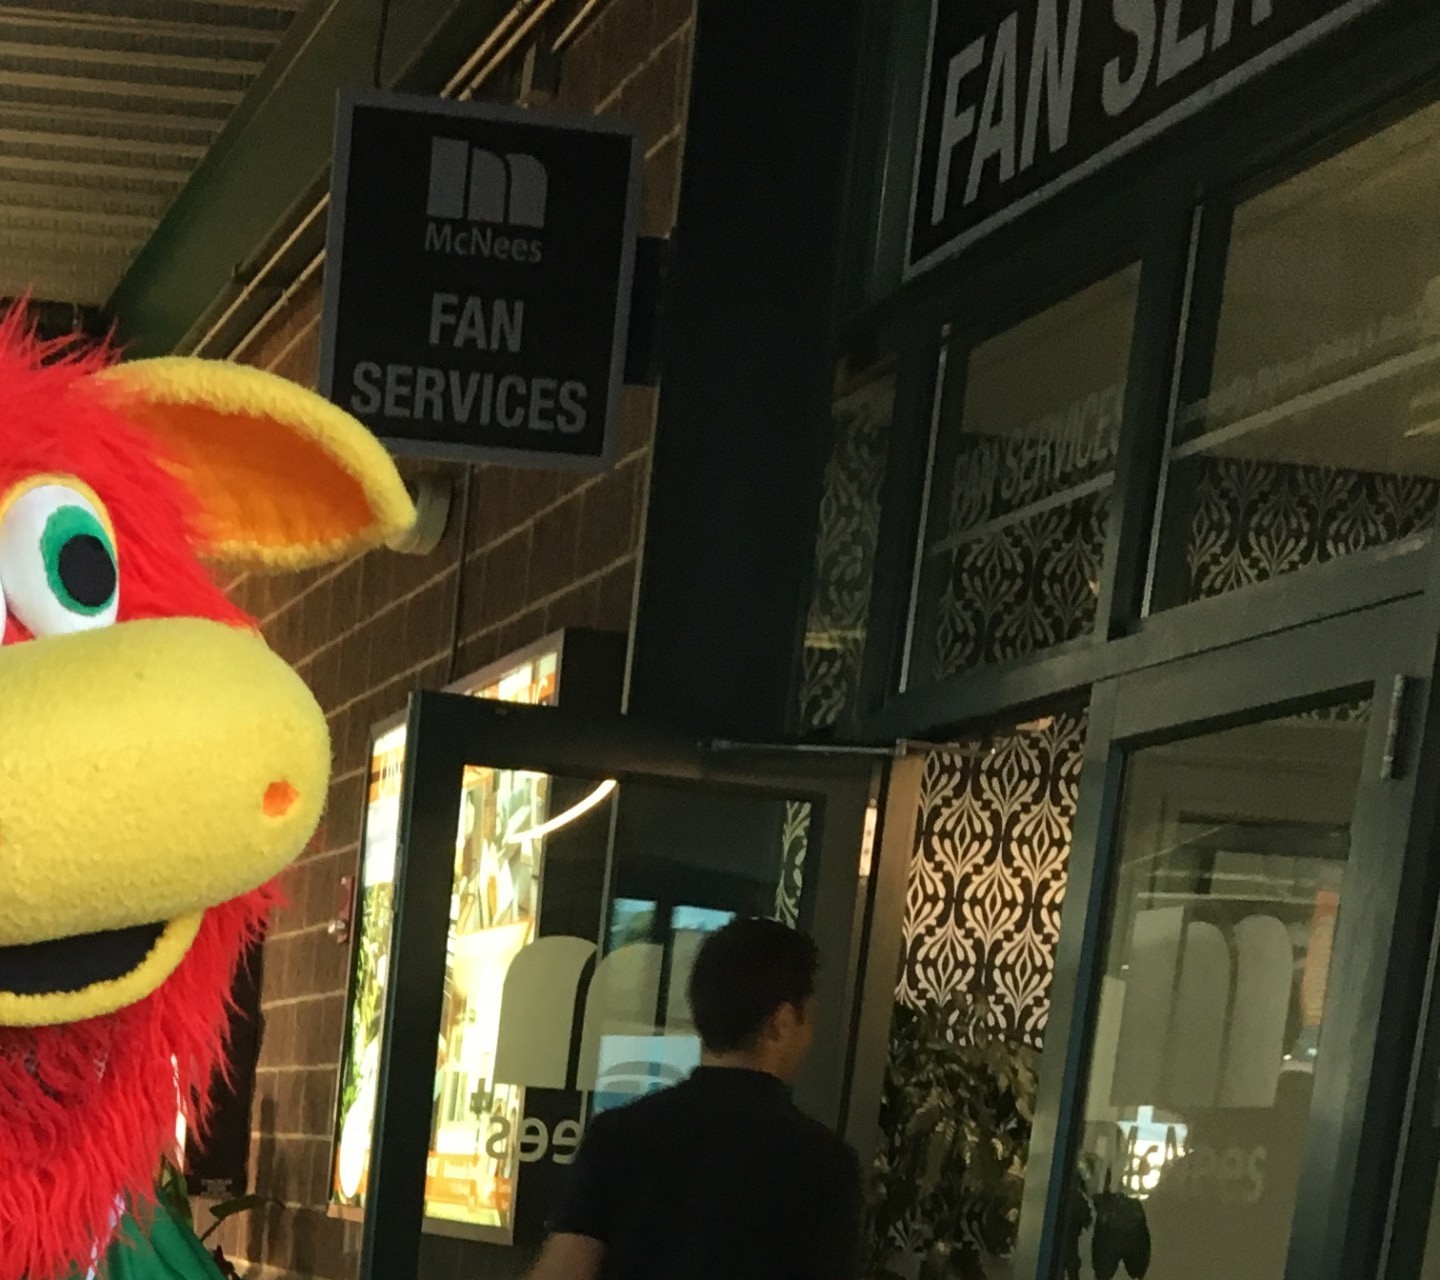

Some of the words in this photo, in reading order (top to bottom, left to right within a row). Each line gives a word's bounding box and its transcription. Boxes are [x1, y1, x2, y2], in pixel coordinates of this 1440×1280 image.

[932, 0, 1083, 227] FAN
[423, 220, 543, 264] McNees
[428, 291, 524, 353] FAN
[350, 361, 588, 434] SERVICES
